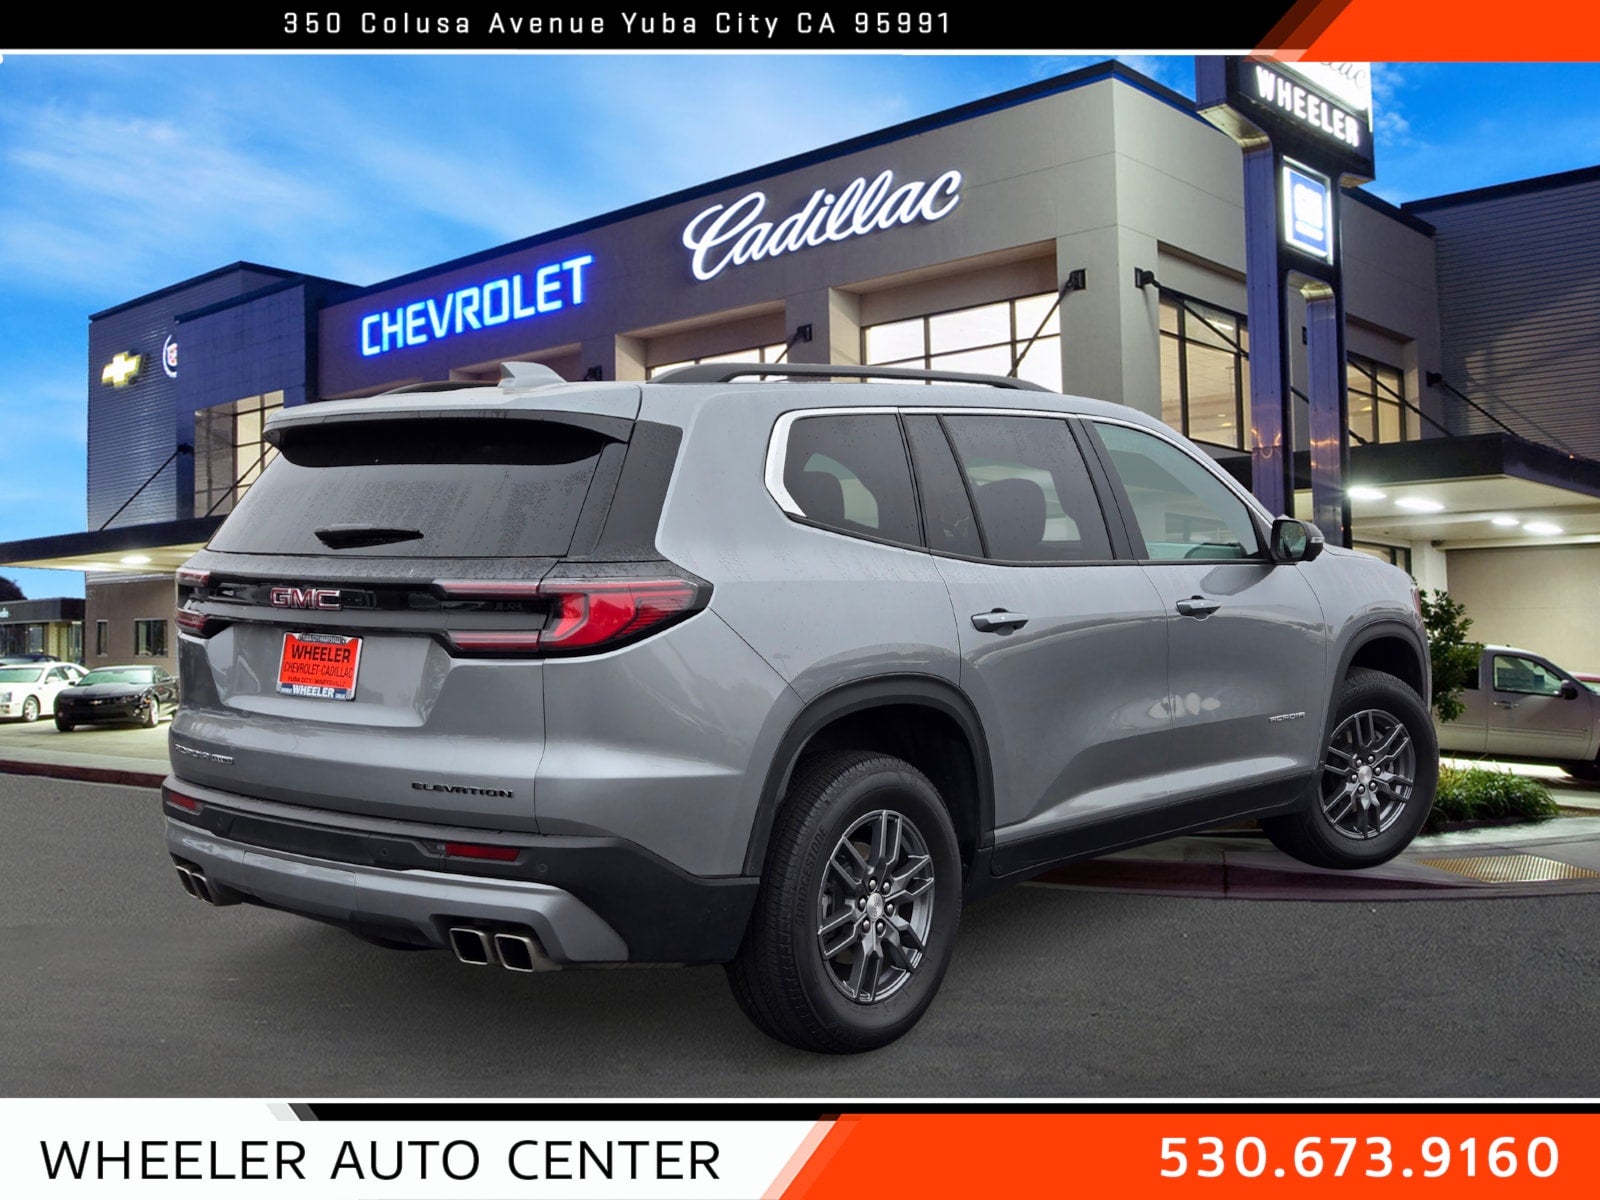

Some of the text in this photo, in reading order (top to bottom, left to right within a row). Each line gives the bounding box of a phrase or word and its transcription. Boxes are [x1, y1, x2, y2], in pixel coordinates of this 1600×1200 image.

[1256, 65, 1359, 148] WHEELER
[682, 169, 962, 281] Cadillac
[361, 254, 593, 357] CHEVROLET
[270, 587, 340, 610] GMC
[291, 644, 351, 663] WHEELER
[292, 684, 335, 698] WHEELER
[411, 782, 514, 799] ELEVATION
